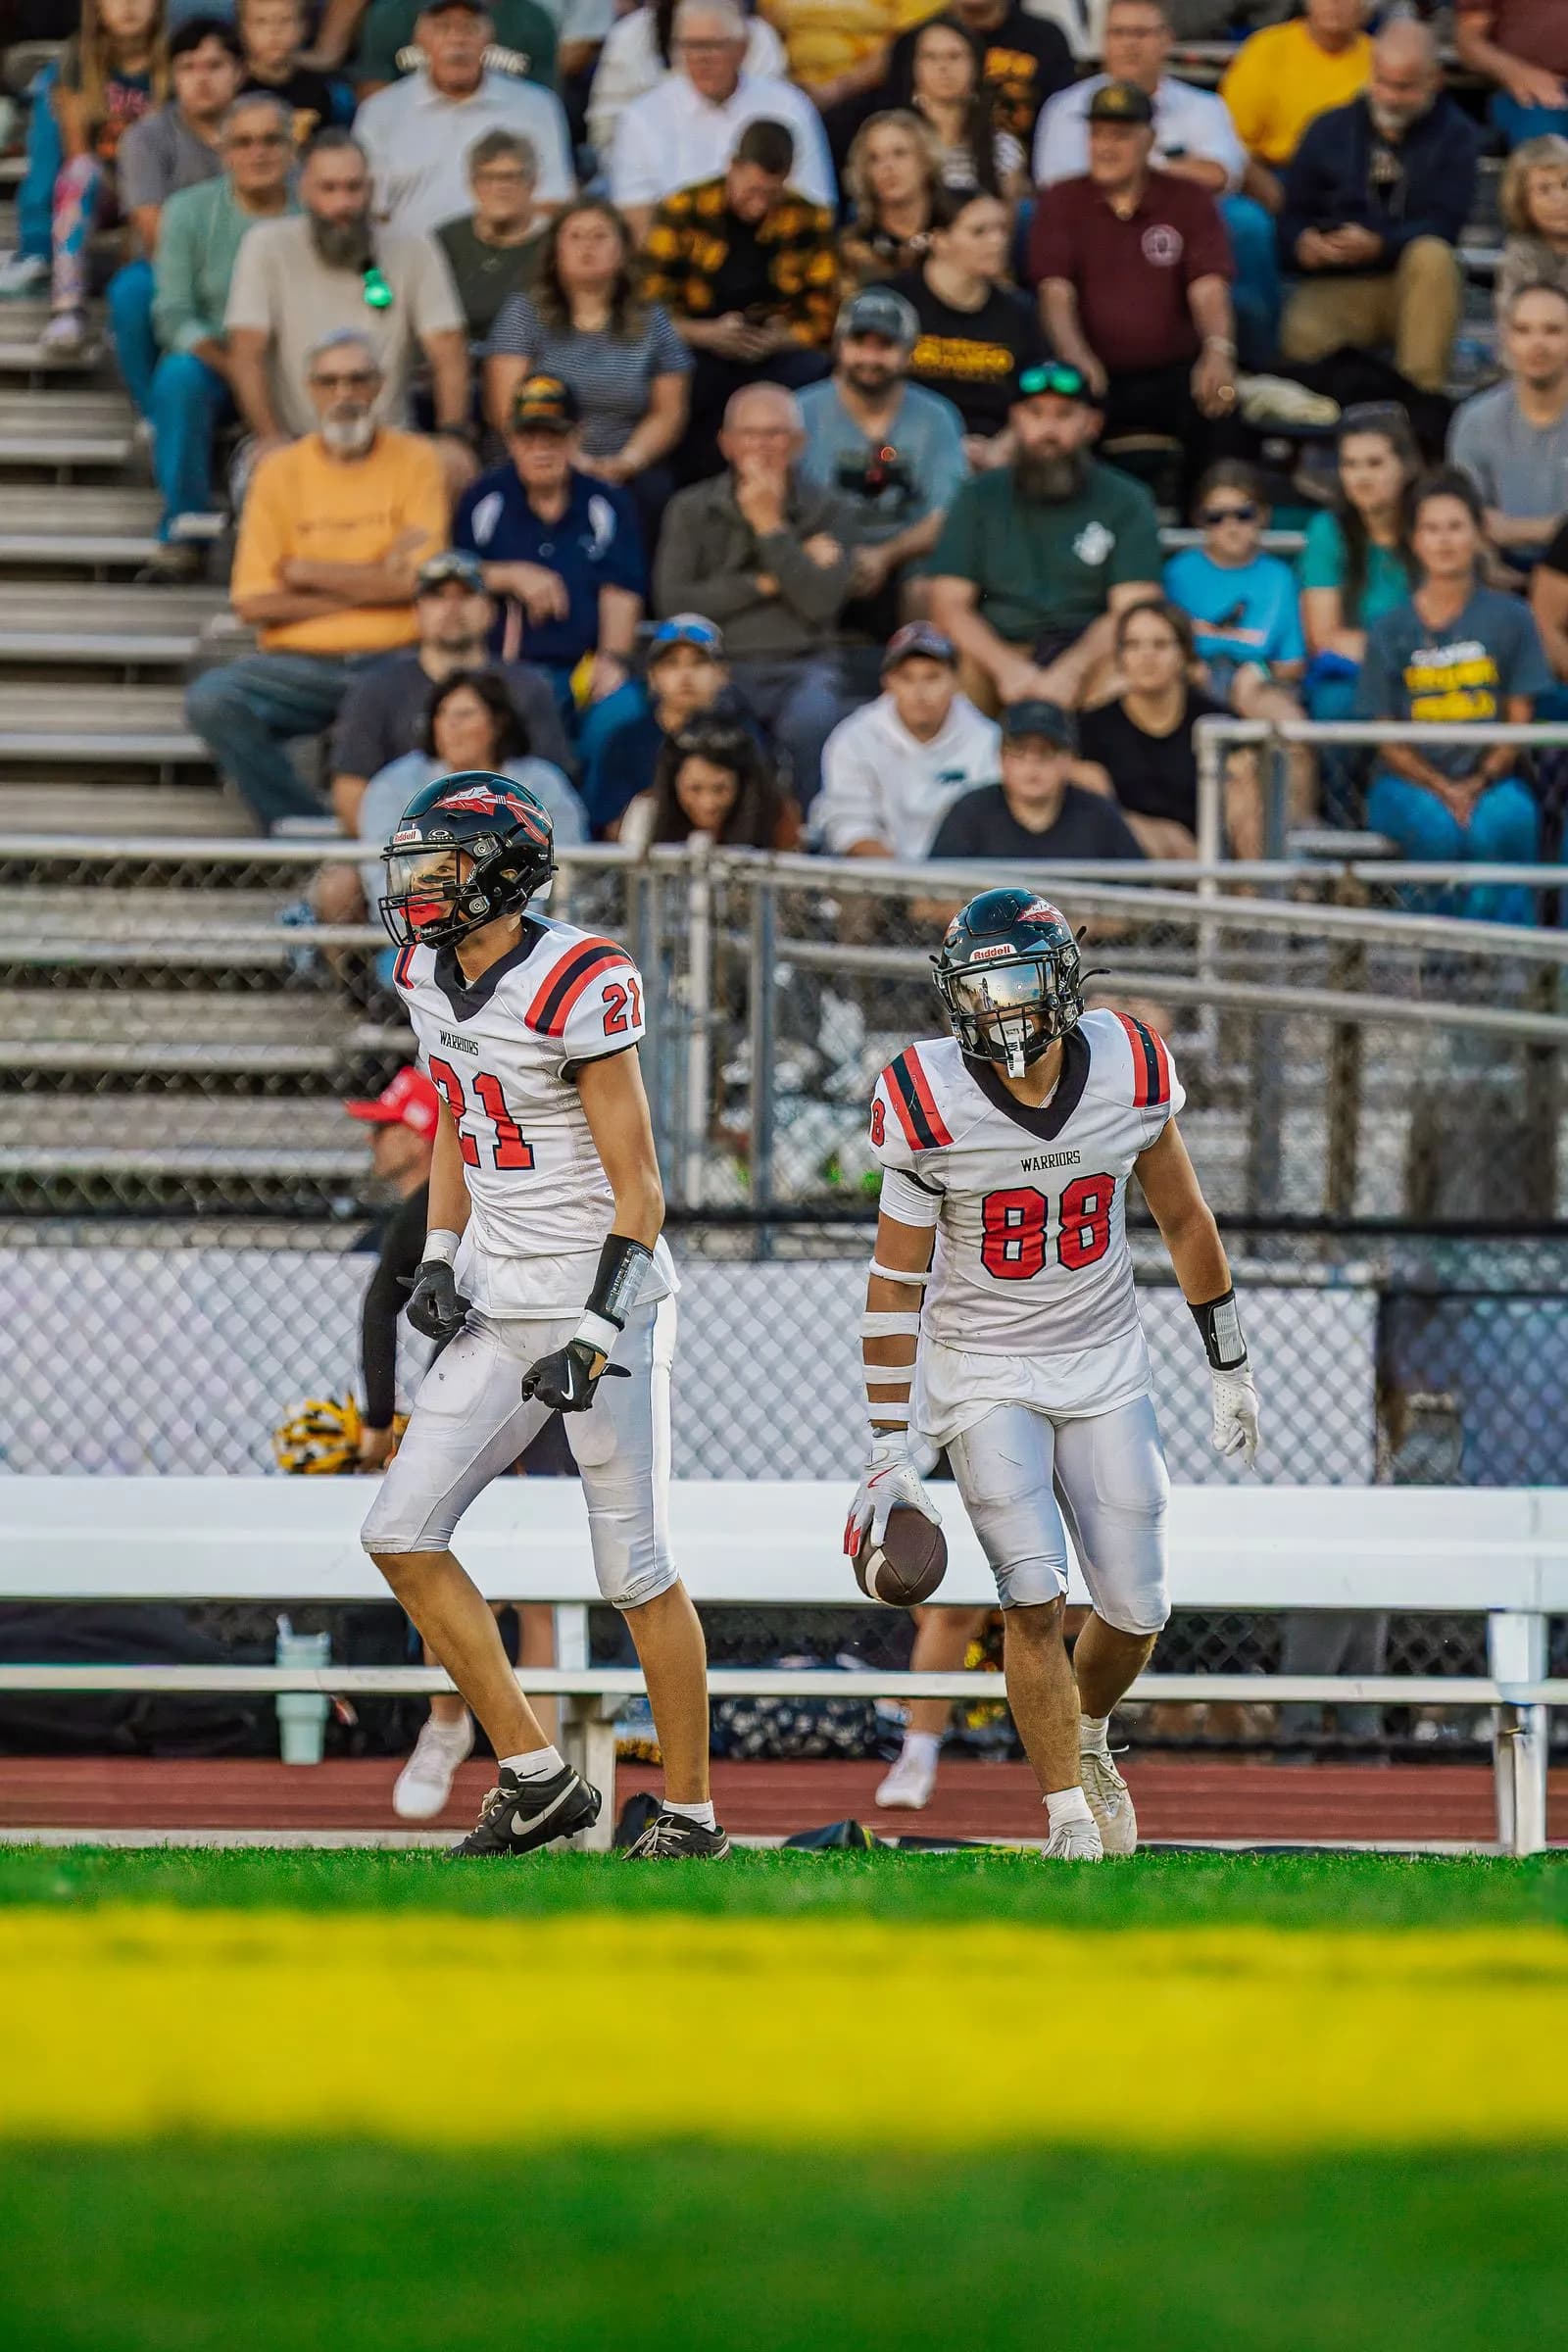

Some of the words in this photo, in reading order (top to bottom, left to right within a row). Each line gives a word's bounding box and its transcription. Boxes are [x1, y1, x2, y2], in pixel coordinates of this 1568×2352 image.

[974, 946, 1010, 959] Riddell
[602, 978, 642, 1037] 21
[439, 1030, 479, 1055] WARRIORS
[1020, 1151, 1081, 1172] WARRIORS
[981, 1172, 1116, 1280] 88
